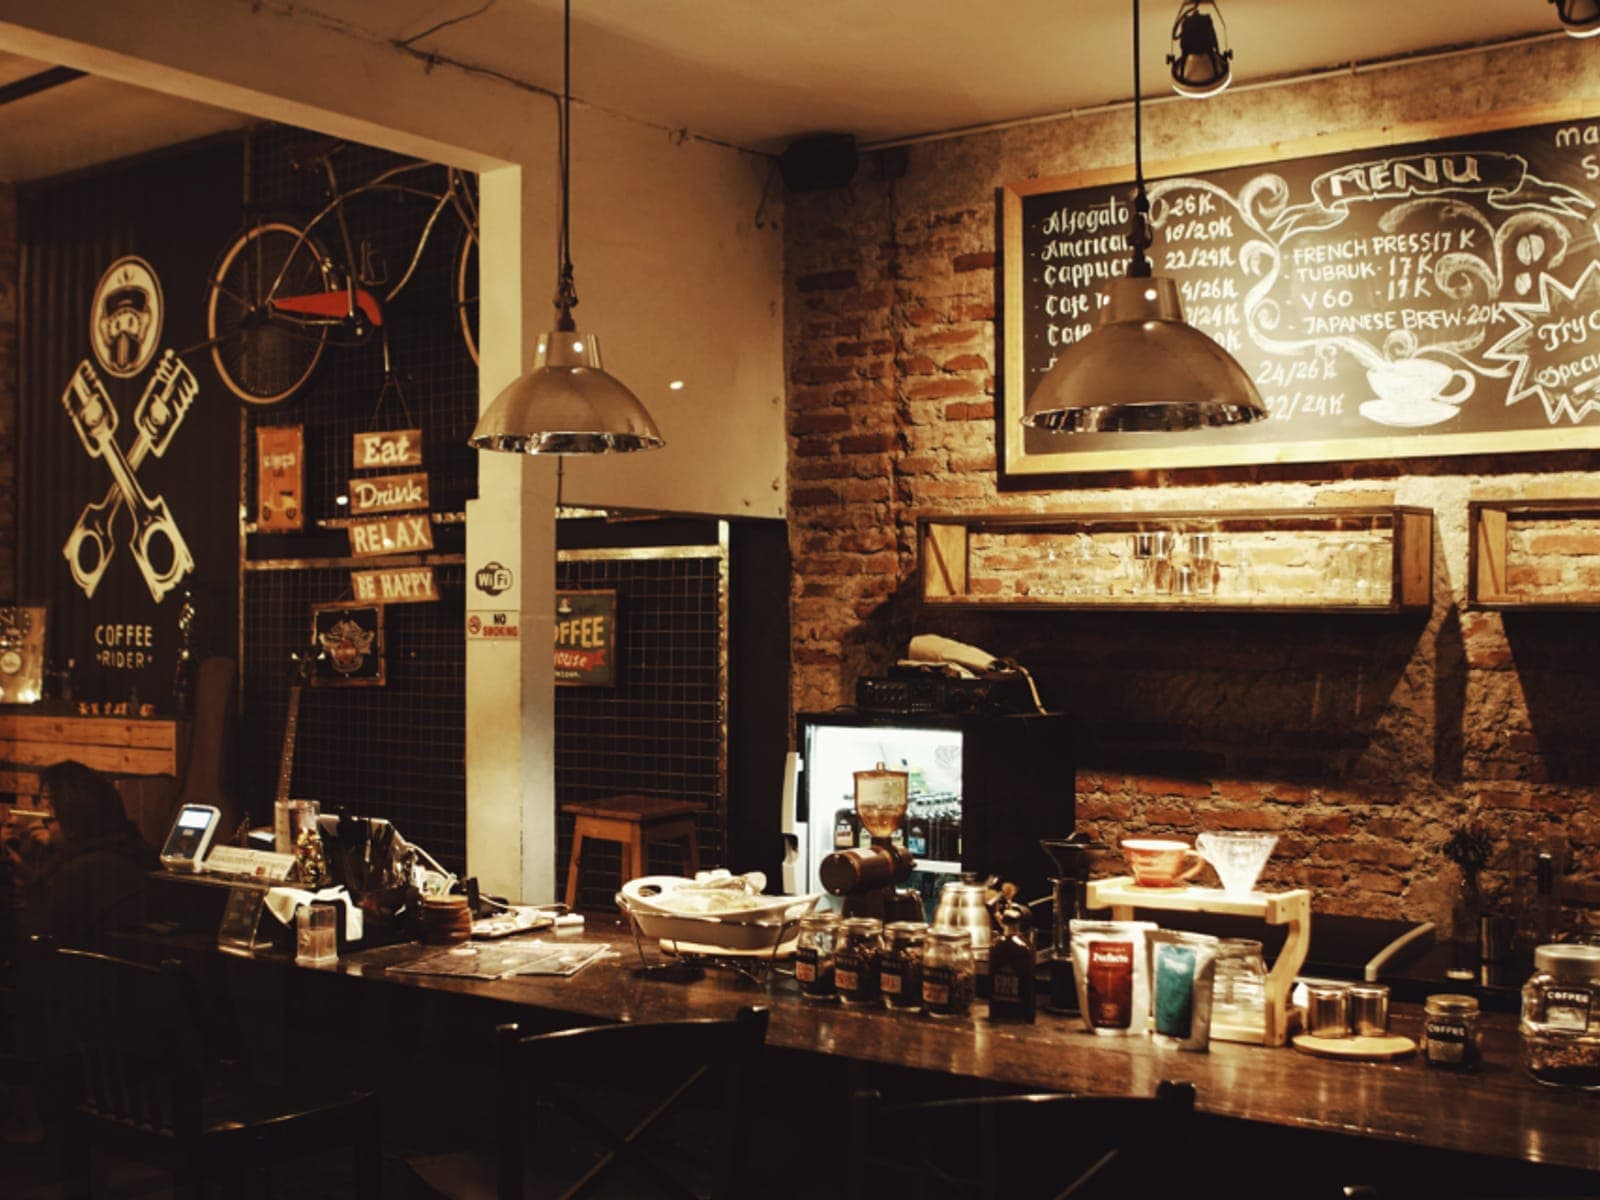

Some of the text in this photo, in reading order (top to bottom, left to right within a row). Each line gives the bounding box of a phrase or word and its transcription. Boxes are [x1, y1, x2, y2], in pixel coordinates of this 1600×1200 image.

[1330, 156, 1482, 196] MENU
[1293, 238, 1368, 265] FRENCH
[1303, 311, 1396, 335] JAPANESE
[362, 435, 411, 466] Eat
[355, 479, 423, 508] Drink
[353, 517, 428, 553] RELAX
[357, 571, 433, 599] BE HAPPY
[482, 626, 520, 637] SMOKING
[493, 613, 507, 625] NO
[95, 624, 152, 647] COFFEE
[1546, 991, 1589, 1004] COFFEE
[1427, 1023, 1465, 1037] COFFEE
